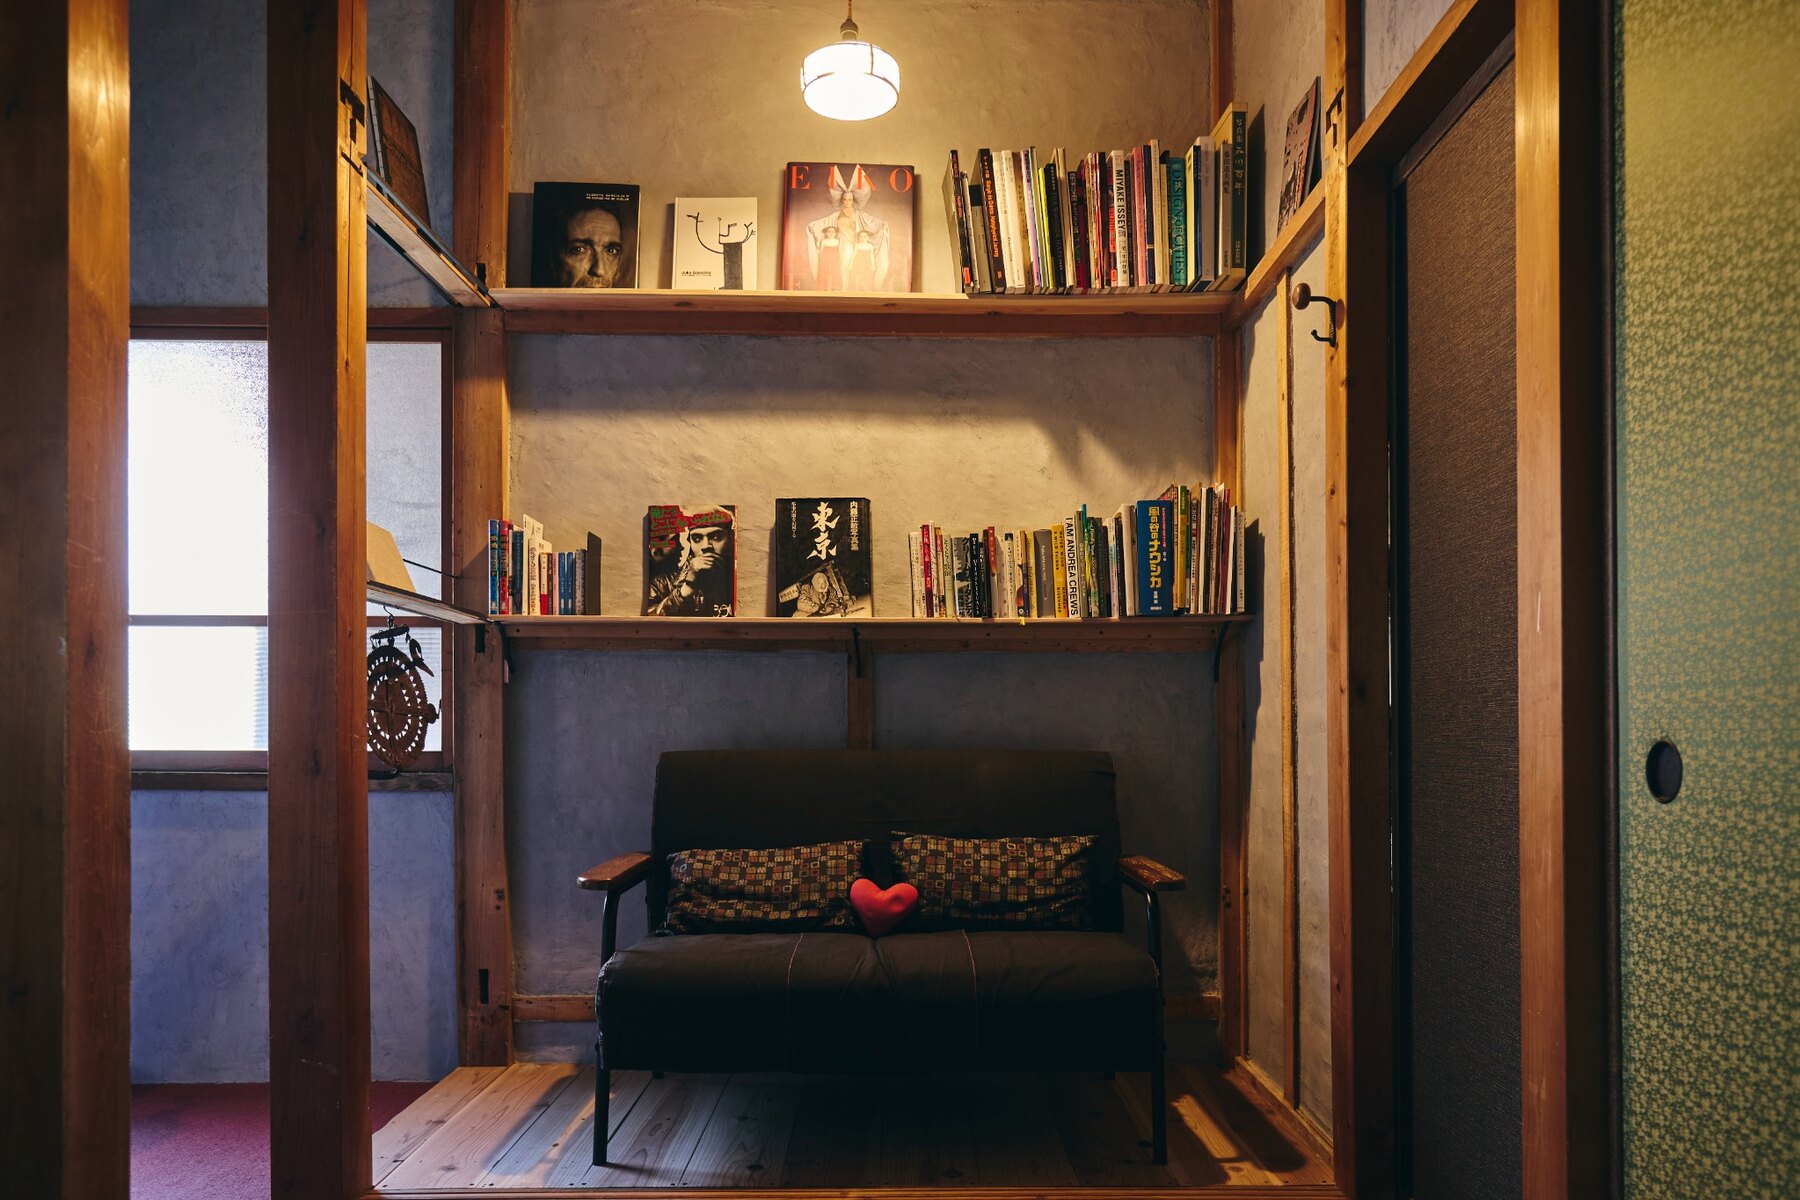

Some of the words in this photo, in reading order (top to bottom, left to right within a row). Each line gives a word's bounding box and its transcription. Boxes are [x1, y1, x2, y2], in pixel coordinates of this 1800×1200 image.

[791, 164, 913, 193] EIKO
[1115, 169, 1125, 203] MIYAKE
[1172, 169, 1185, 218] DESIGN
[1117, 204, 1126, 230] ISSEY
[1174, 234, 1186, 275] CITIES
[806, 501, 841, 561] 東京
[1065, 522, 1074, 537] AM
[1066, 538, 1076, 578] ANDREA
[1068, 580, 1079, 616] CREWS
